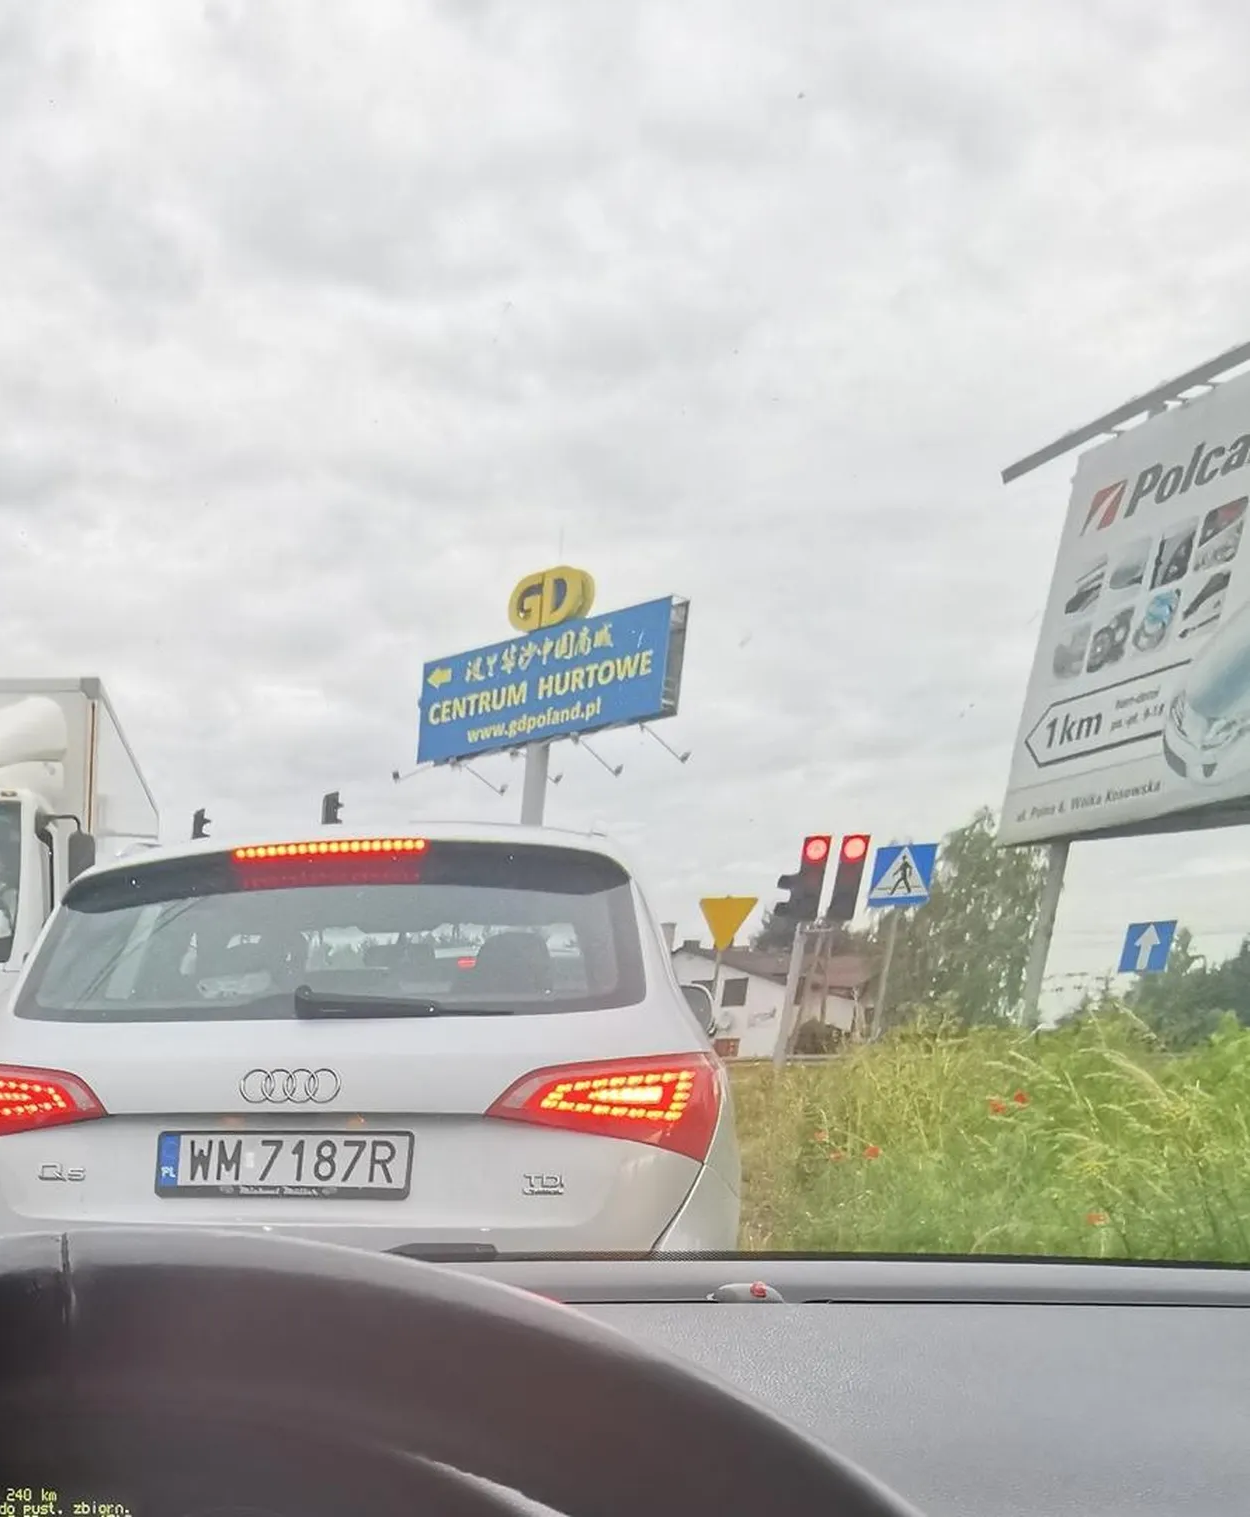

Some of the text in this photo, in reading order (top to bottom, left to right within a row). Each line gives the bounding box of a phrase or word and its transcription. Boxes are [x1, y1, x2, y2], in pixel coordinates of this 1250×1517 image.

[1123, 433, 1250, 519] Polca
[508, 566, 588, 632] GD
[428, 649, 653, 726] CENTRUM HURTOWE
[466, 697, 601, 743] www.gdpoland.pl
[37, 1162, 86, 1182] Q5
[161, 1166, 176, 1178] PL
[189, 1139, 398, 1184] WM 7187R
[523, 1173, 564, 1188] TDI
[6, 1487, 57, 1501] 240 km
[23, 1502, 63, 1515] pust.
[72, 1501, 130, 1515] zbiorn.
